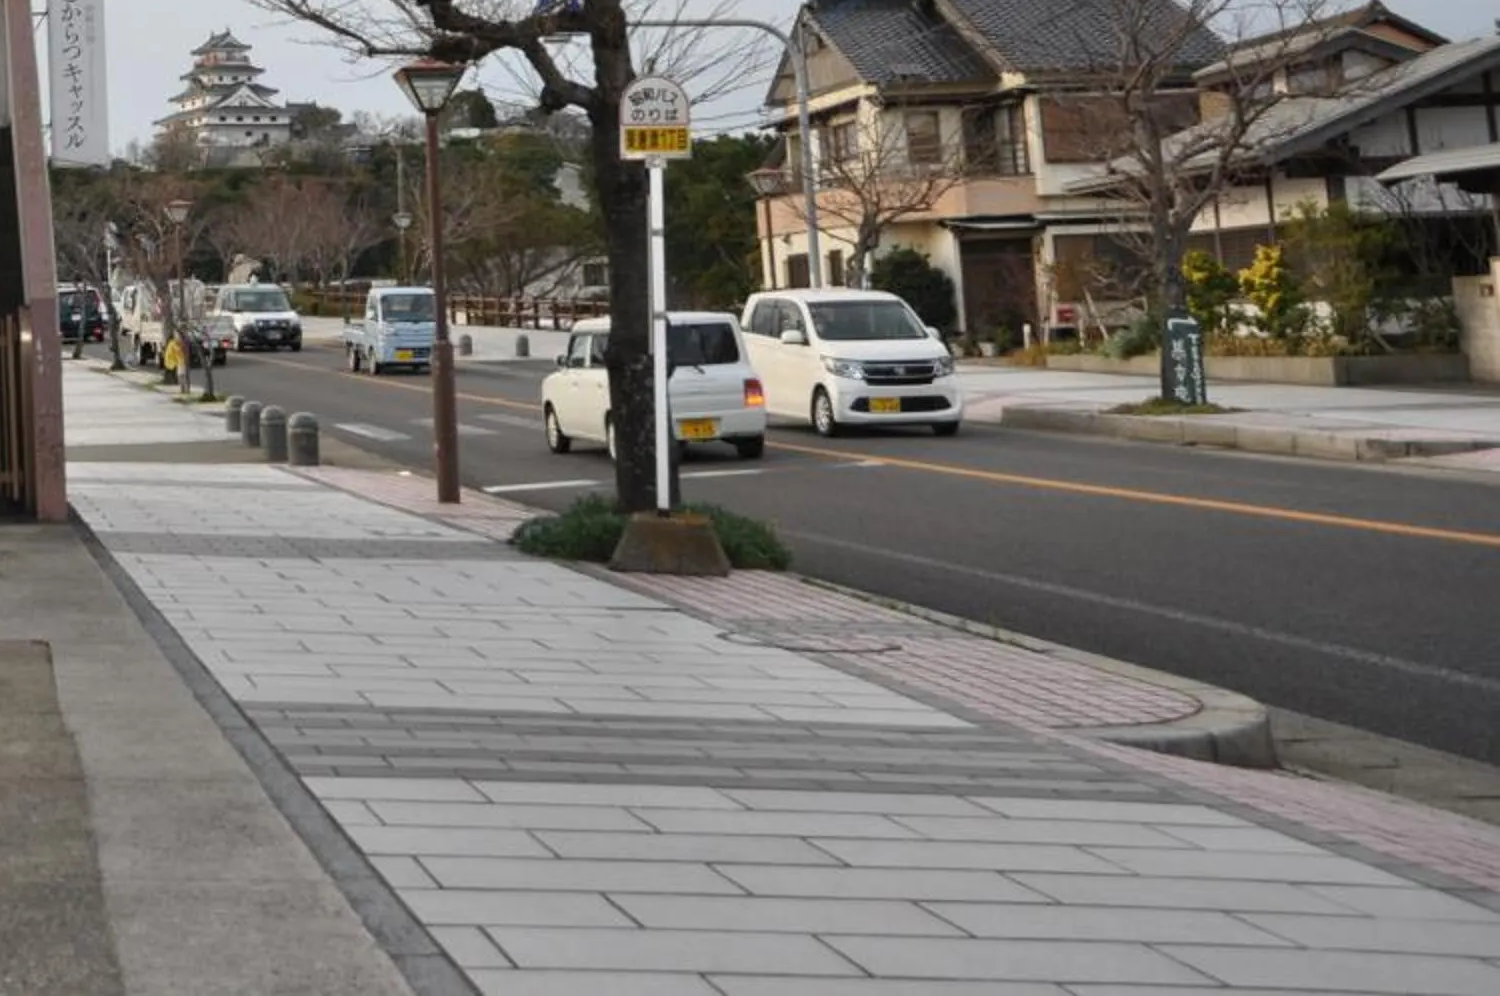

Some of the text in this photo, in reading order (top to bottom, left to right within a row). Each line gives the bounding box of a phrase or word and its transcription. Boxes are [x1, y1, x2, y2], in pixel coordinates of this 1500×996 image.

[61, 4, 87, 150] からつキャッスル
[630, 107, 678, 123] のりば
